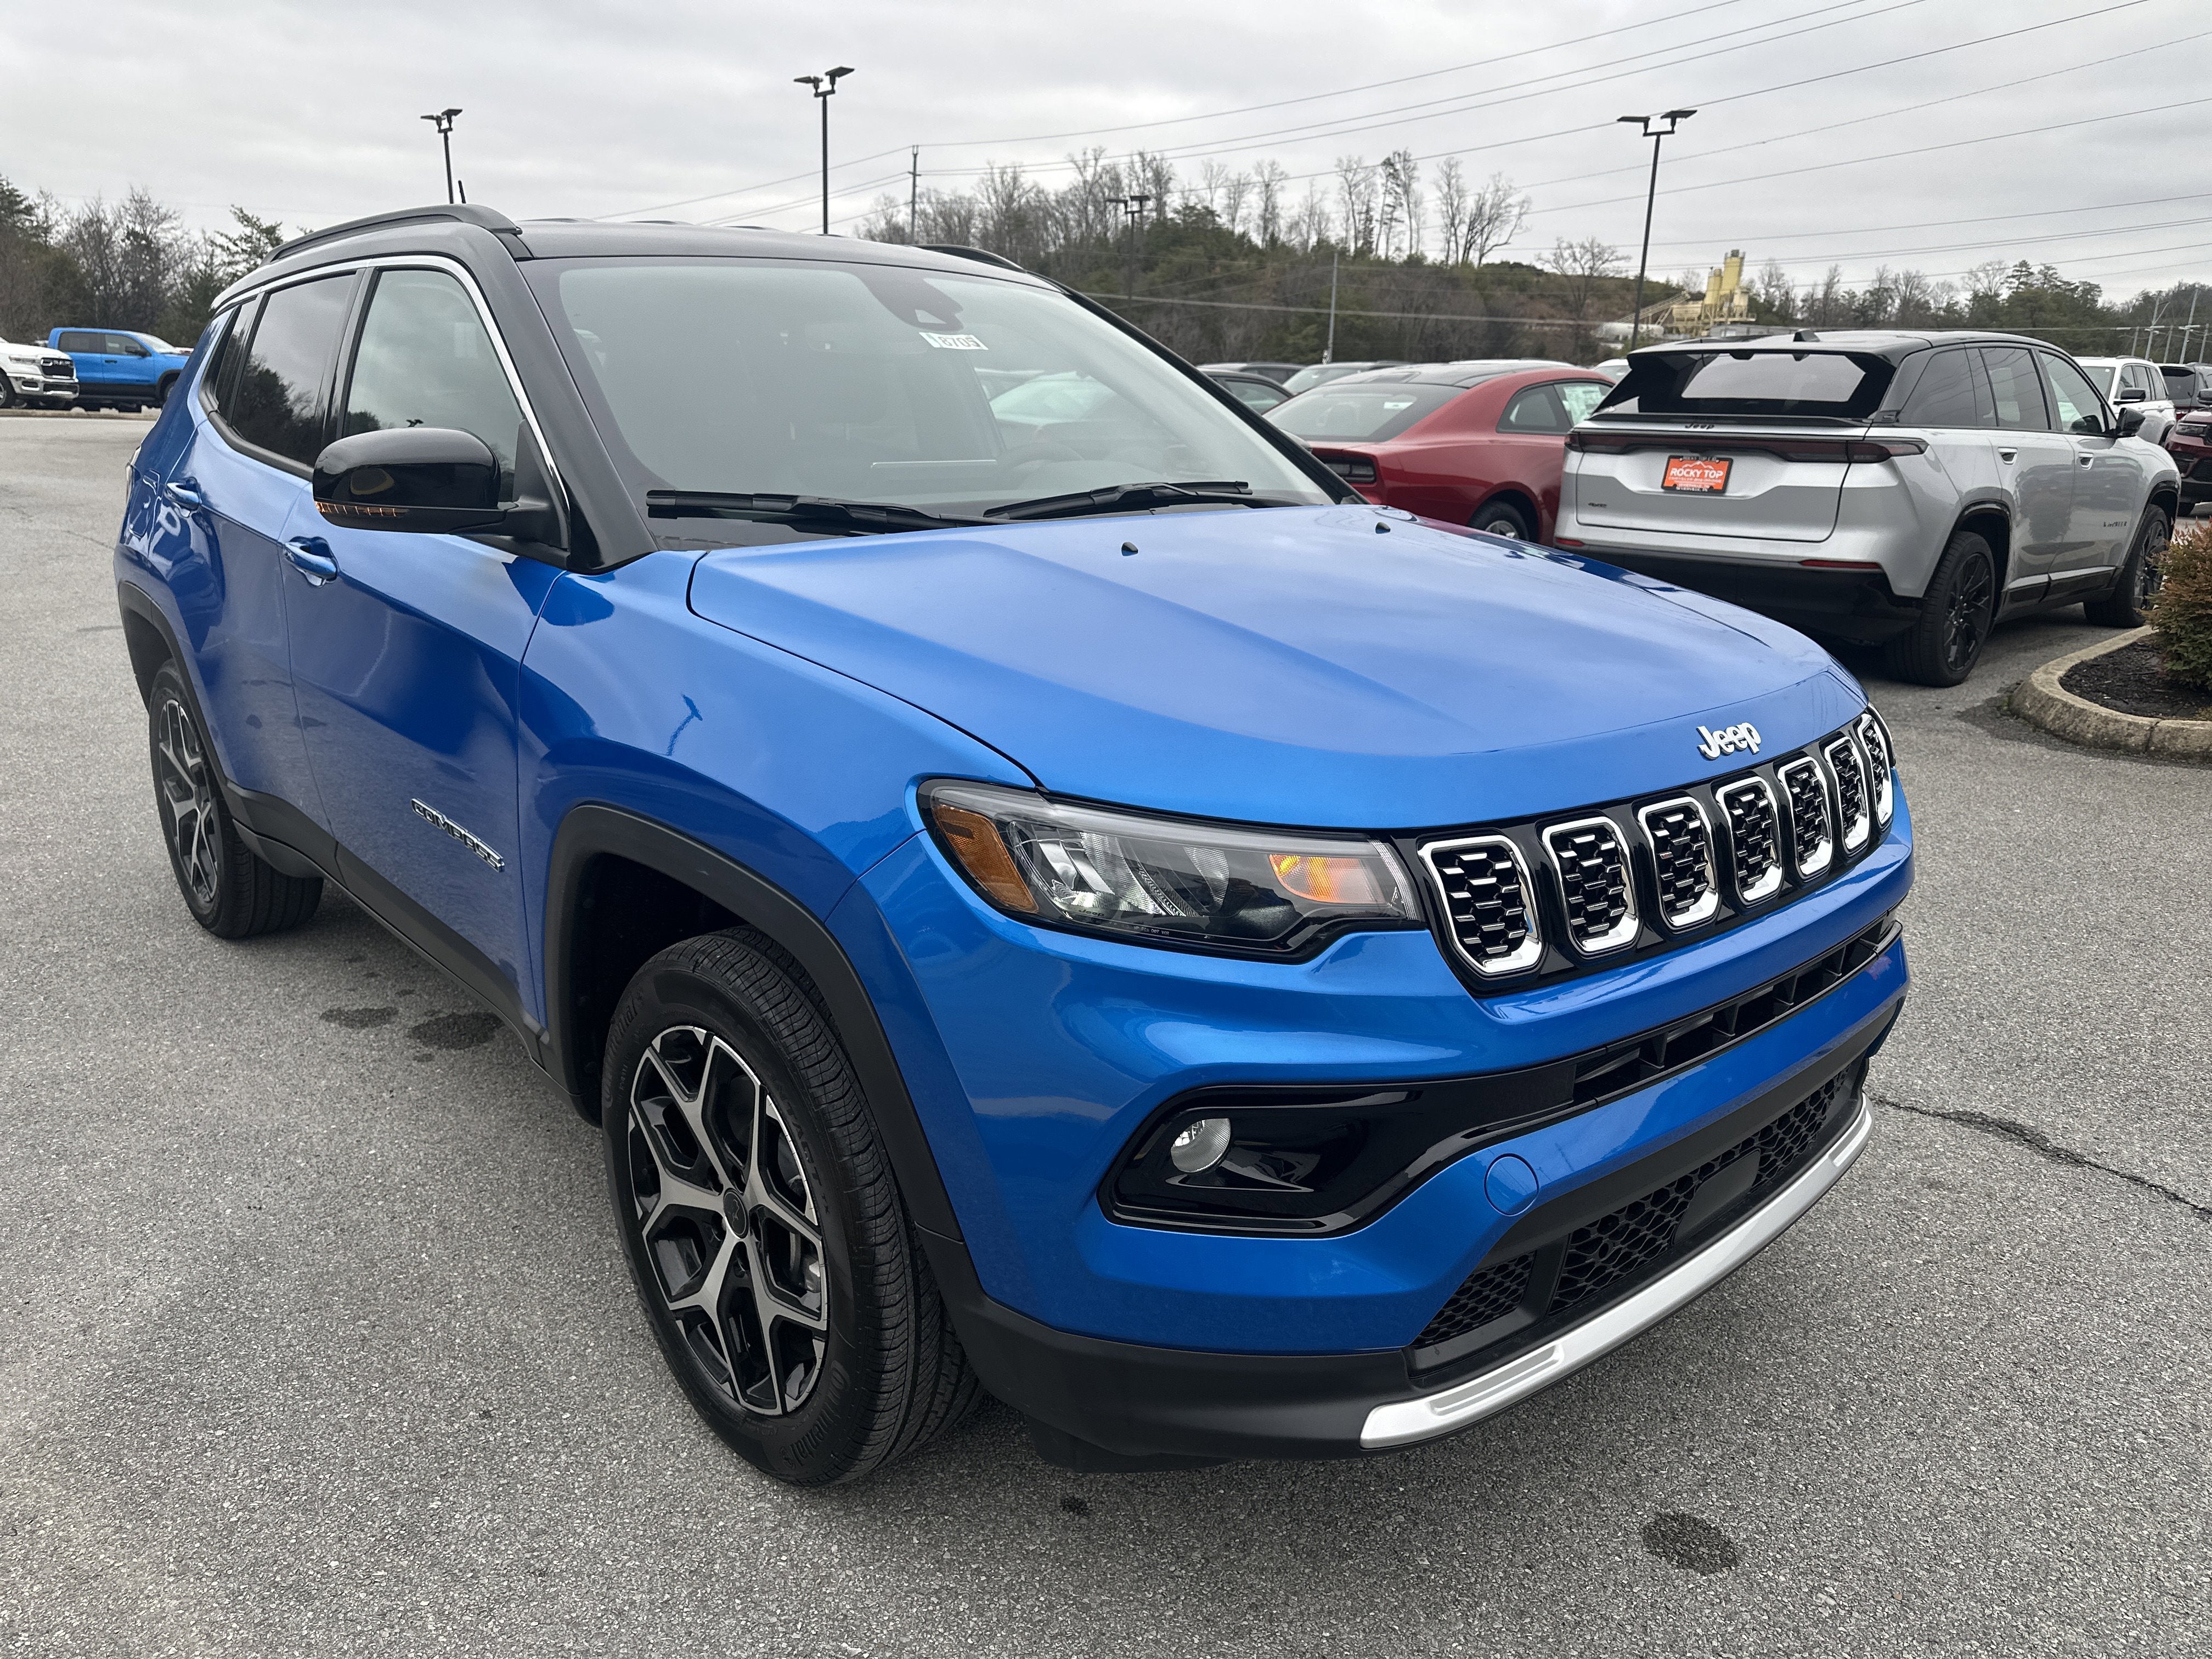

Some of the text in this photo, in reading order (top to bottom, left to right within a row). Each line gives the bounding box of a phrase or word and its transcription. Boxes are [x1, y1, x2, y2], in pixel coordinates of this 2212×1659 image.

[1670, 468, 1724, 479] ROCKY TOP
[1696, 722, 1762, 760] Jeep
[411, 798, 504, 872] COMPASS
[789, 1358, 851, 1466] Continental
